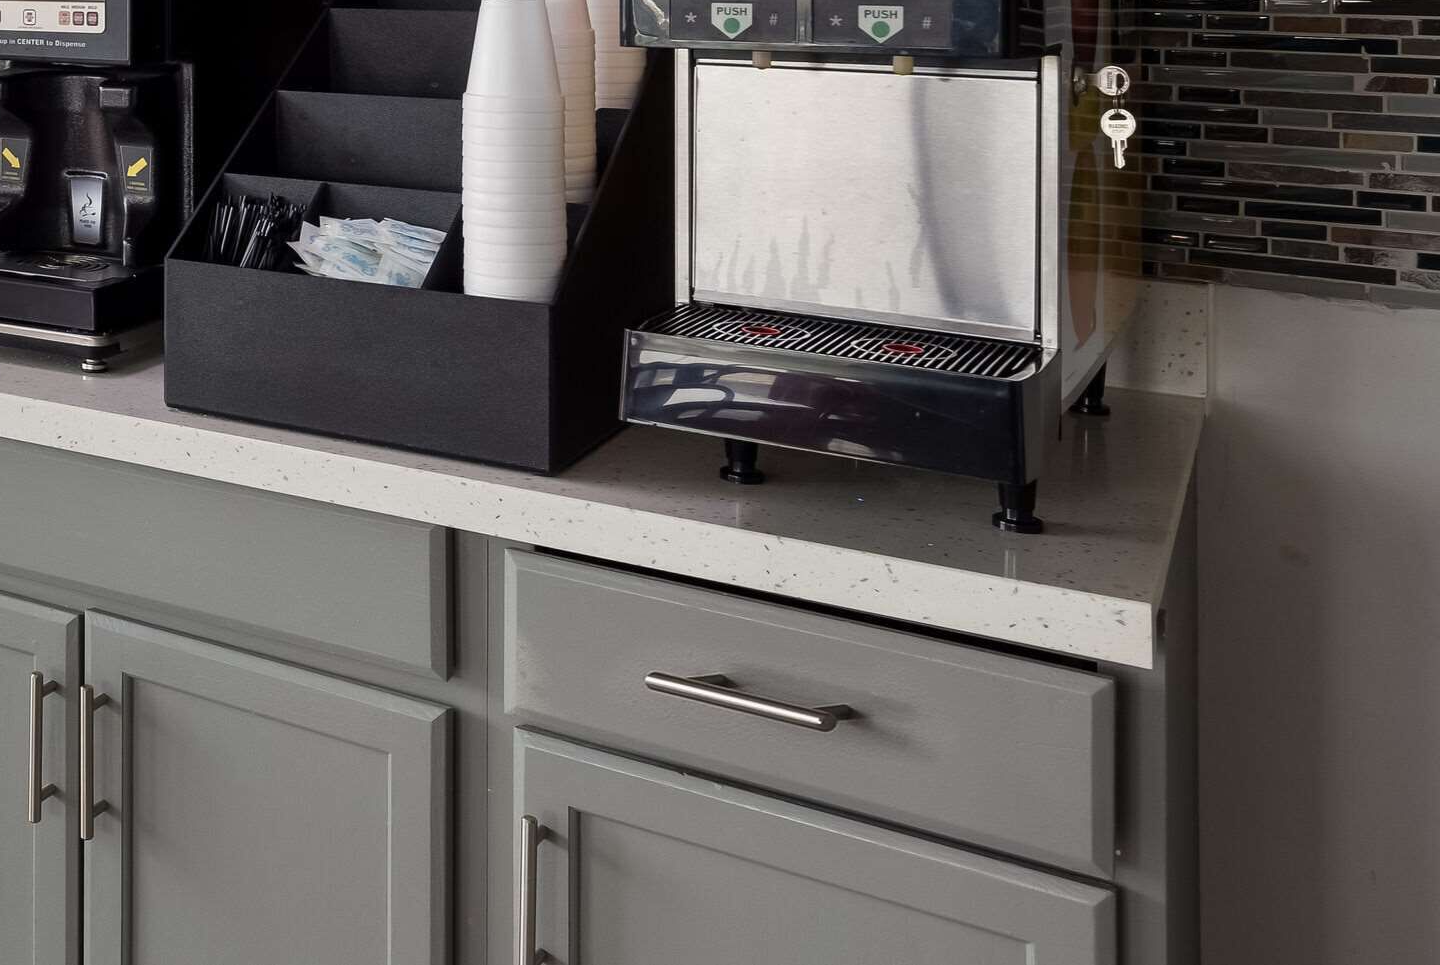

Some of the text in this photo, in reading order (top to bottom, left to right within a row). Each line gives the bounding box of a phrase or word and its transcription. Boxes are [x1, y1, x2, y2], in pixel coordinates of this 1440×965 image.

[716, 6, 748, 17] PUSH
[863, 9, 899, 20] PUSH
[16, 38, 45, 46] CENTER
[54, 40, 87, 49] Dispense
